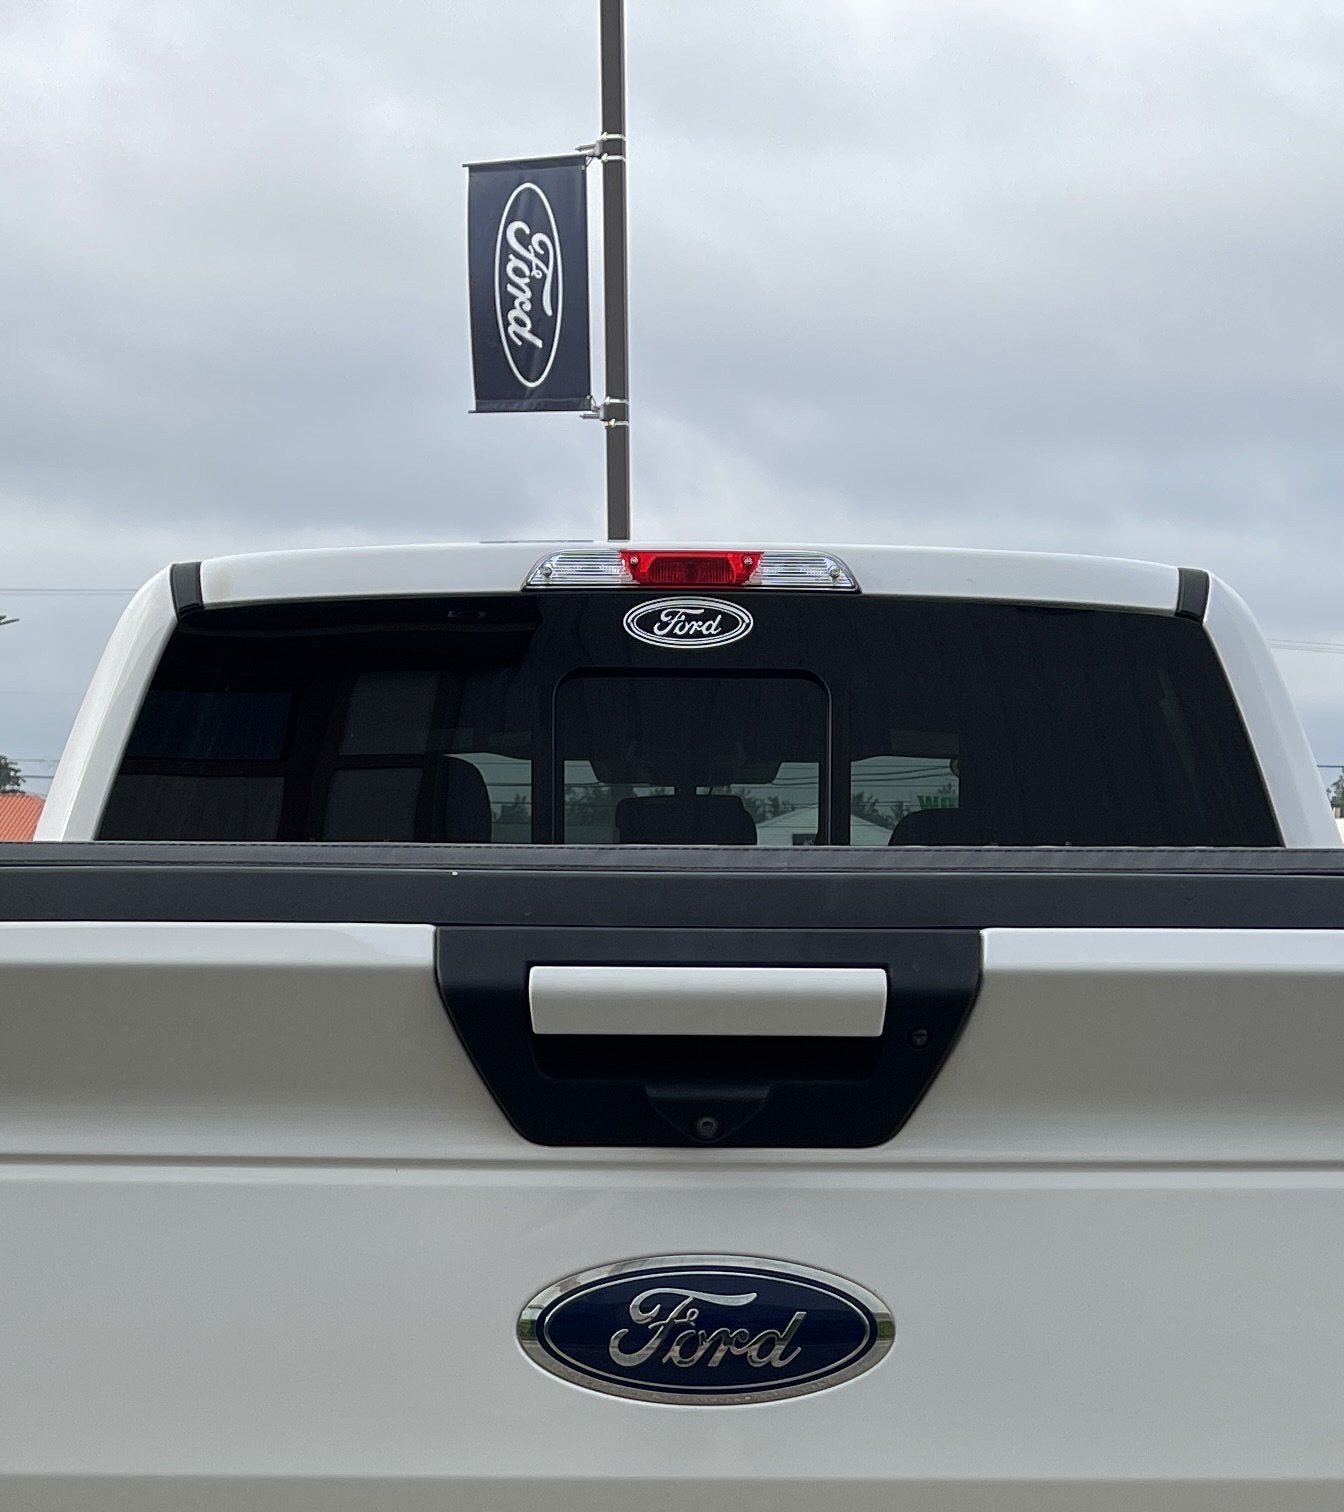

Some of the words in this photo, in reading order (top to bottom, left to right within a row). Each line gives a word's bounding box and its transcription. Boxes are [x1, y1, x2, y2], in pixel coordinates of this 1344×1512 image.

[505, 219, 555, 349] Ford
[652, 608, 723, 637] Ford
[607, 1285, 808, 1371] Ford
